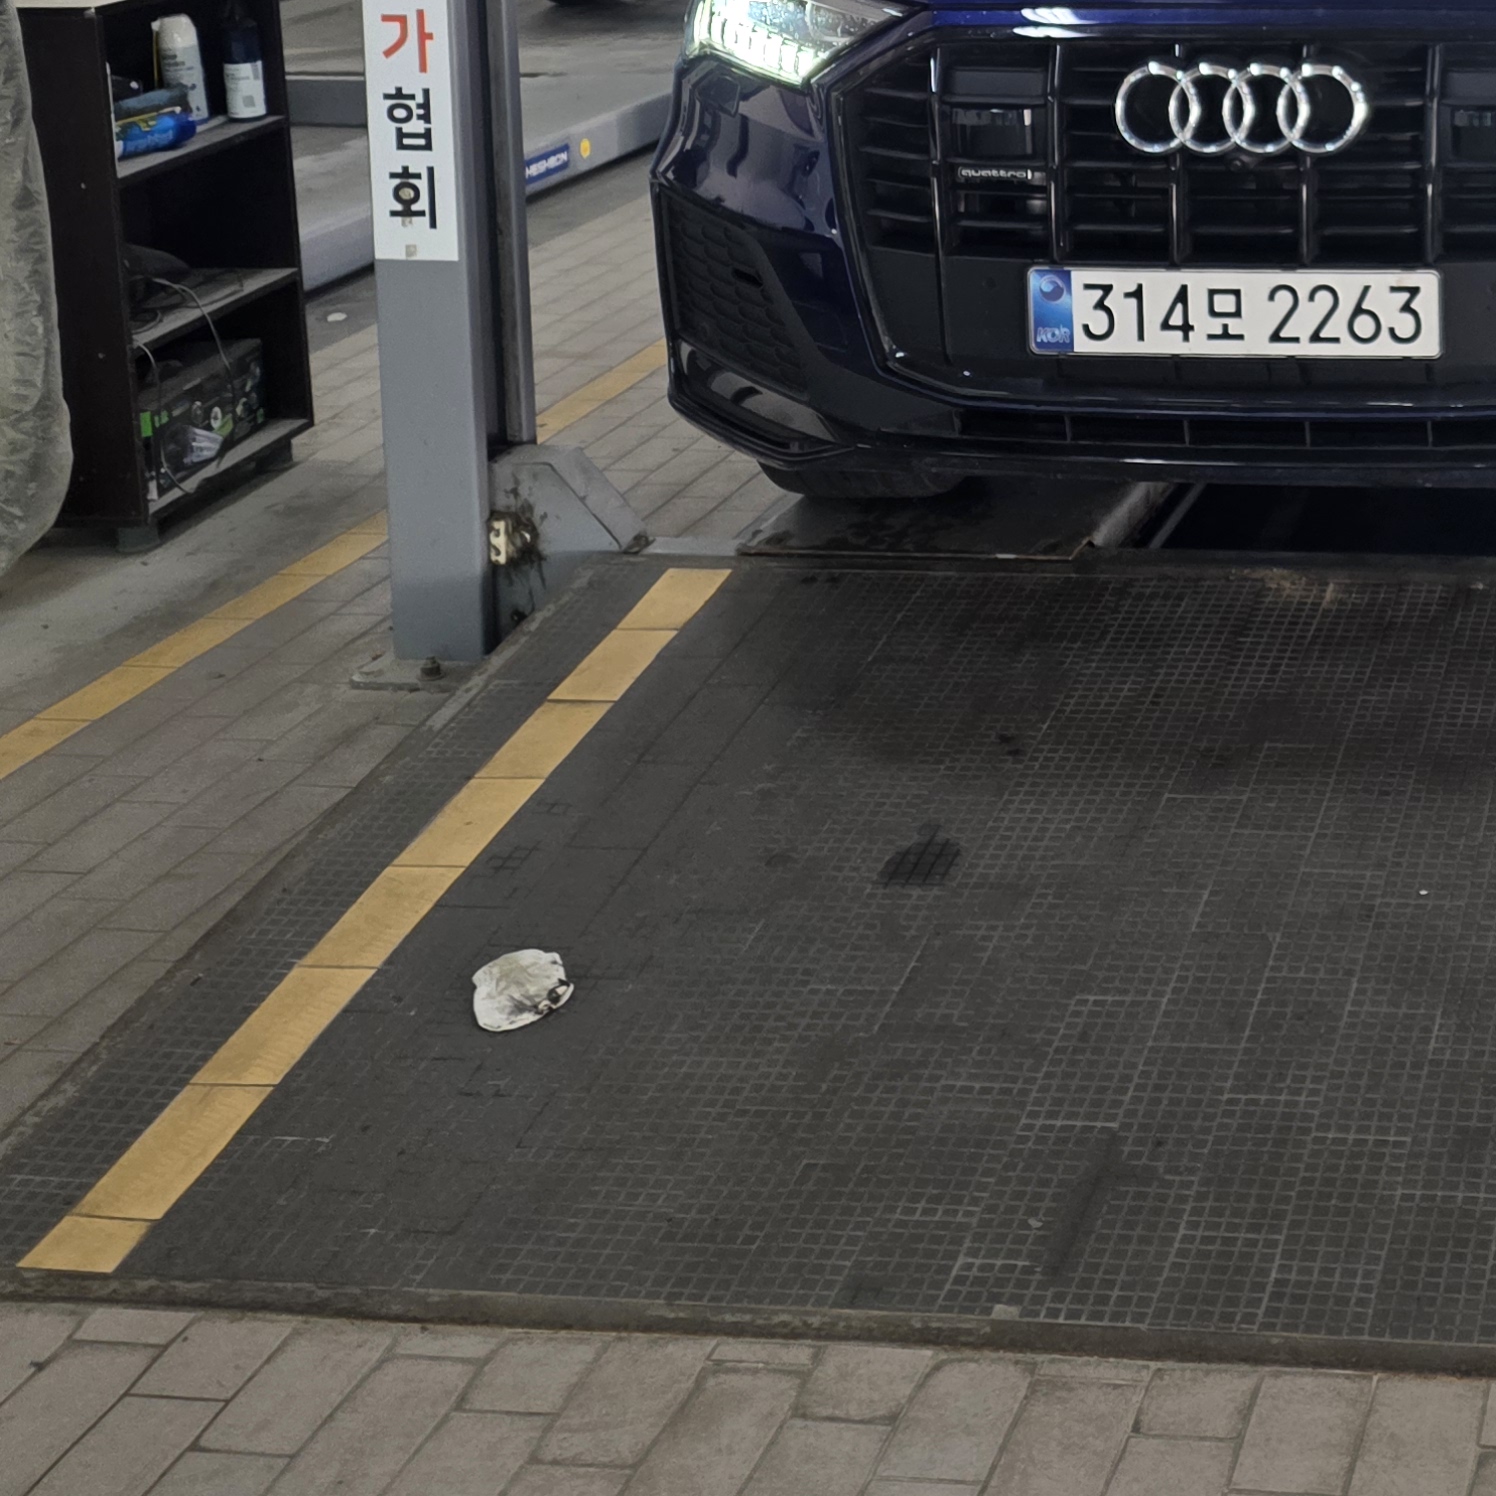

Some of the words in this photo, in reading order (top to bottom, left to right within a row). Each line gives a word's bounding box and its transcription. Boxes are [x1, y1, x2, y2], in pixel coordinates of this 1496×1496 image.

[961, 168, 1027, 178] quattro
[1082, 282, 1245, 343] 314모
[1267, 283, 1422, 345] 2263
[1036, 325, 1071, 344] KOR
